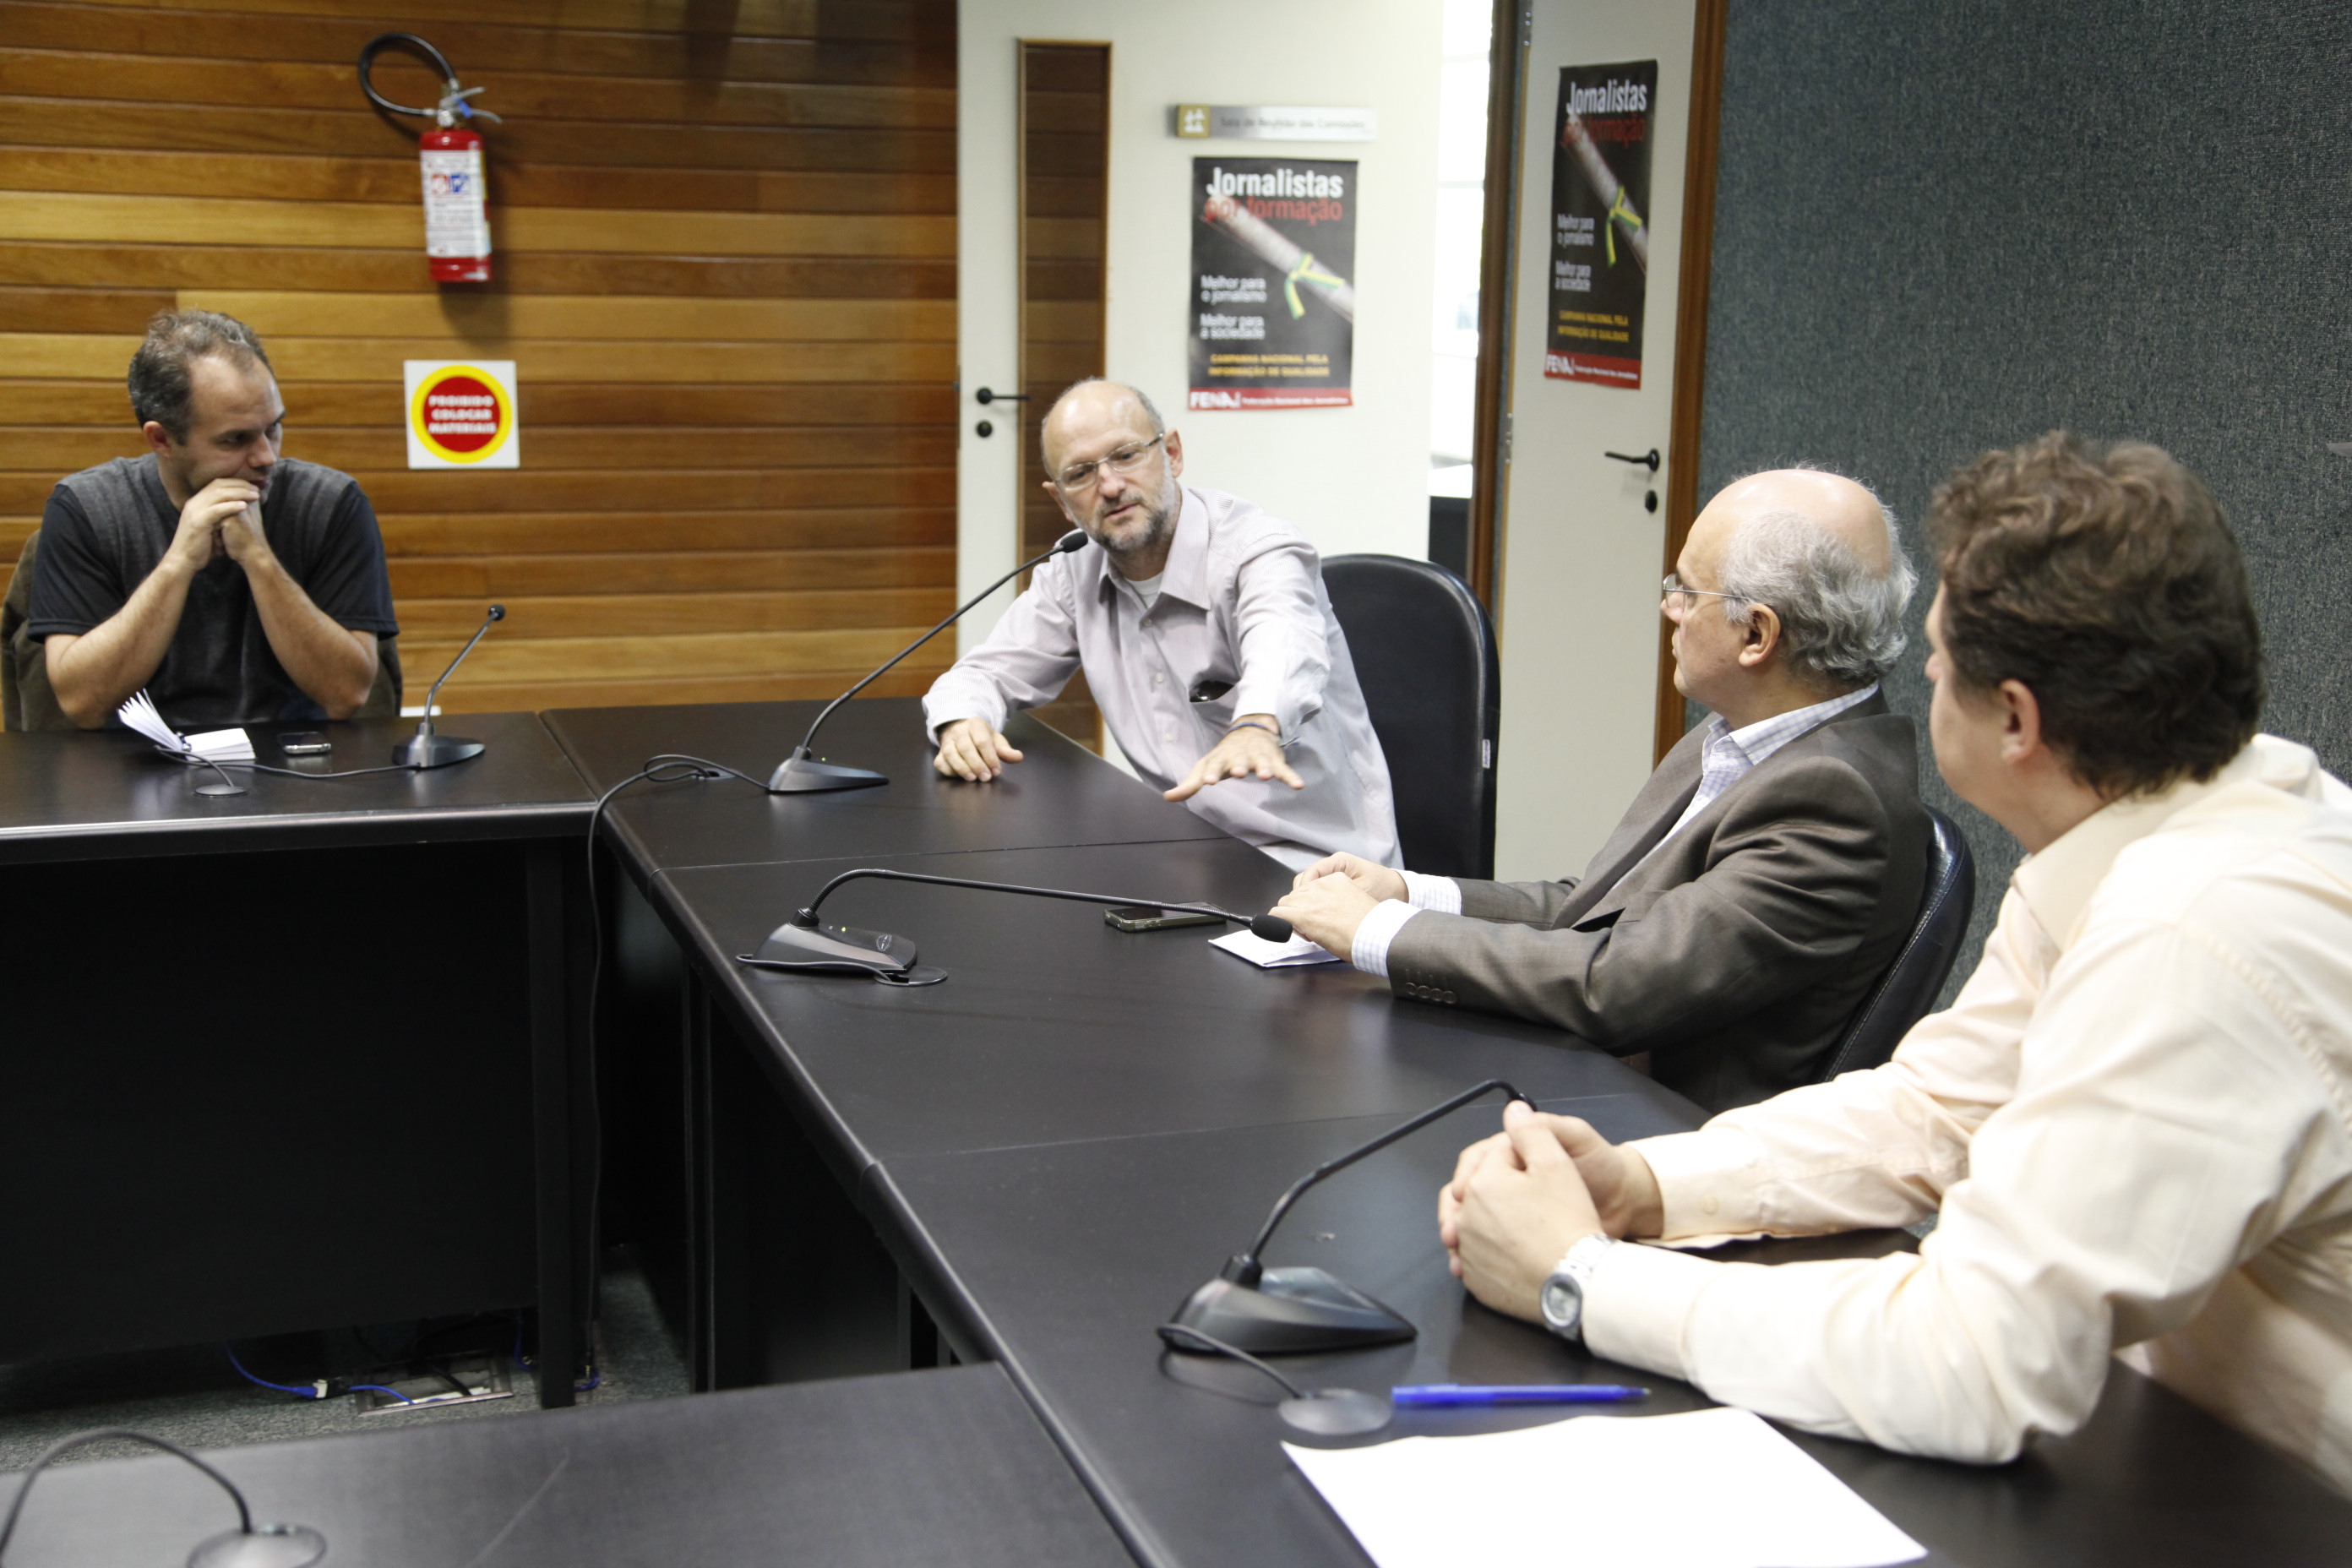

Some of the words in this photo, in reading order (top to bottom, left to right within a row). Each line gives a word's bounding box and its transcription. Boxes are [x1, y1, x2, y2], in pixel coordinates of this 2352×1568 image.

[1566, 79, 1647, 114] Jornalistas
[1206, 166, 1344, 198] Jornalistas
[1246, 195, 1343, 226] formação
[1200, 275, 1239, 289] Melhor
[1239, 278, 1266, 291] para
[1200, 313, 1237, 328] Melhor
[1238, 316, 1265, 330] para
[1190, 391, 1241, 407] FENAJ
[431, 409, 493, 421] COLOCAR
